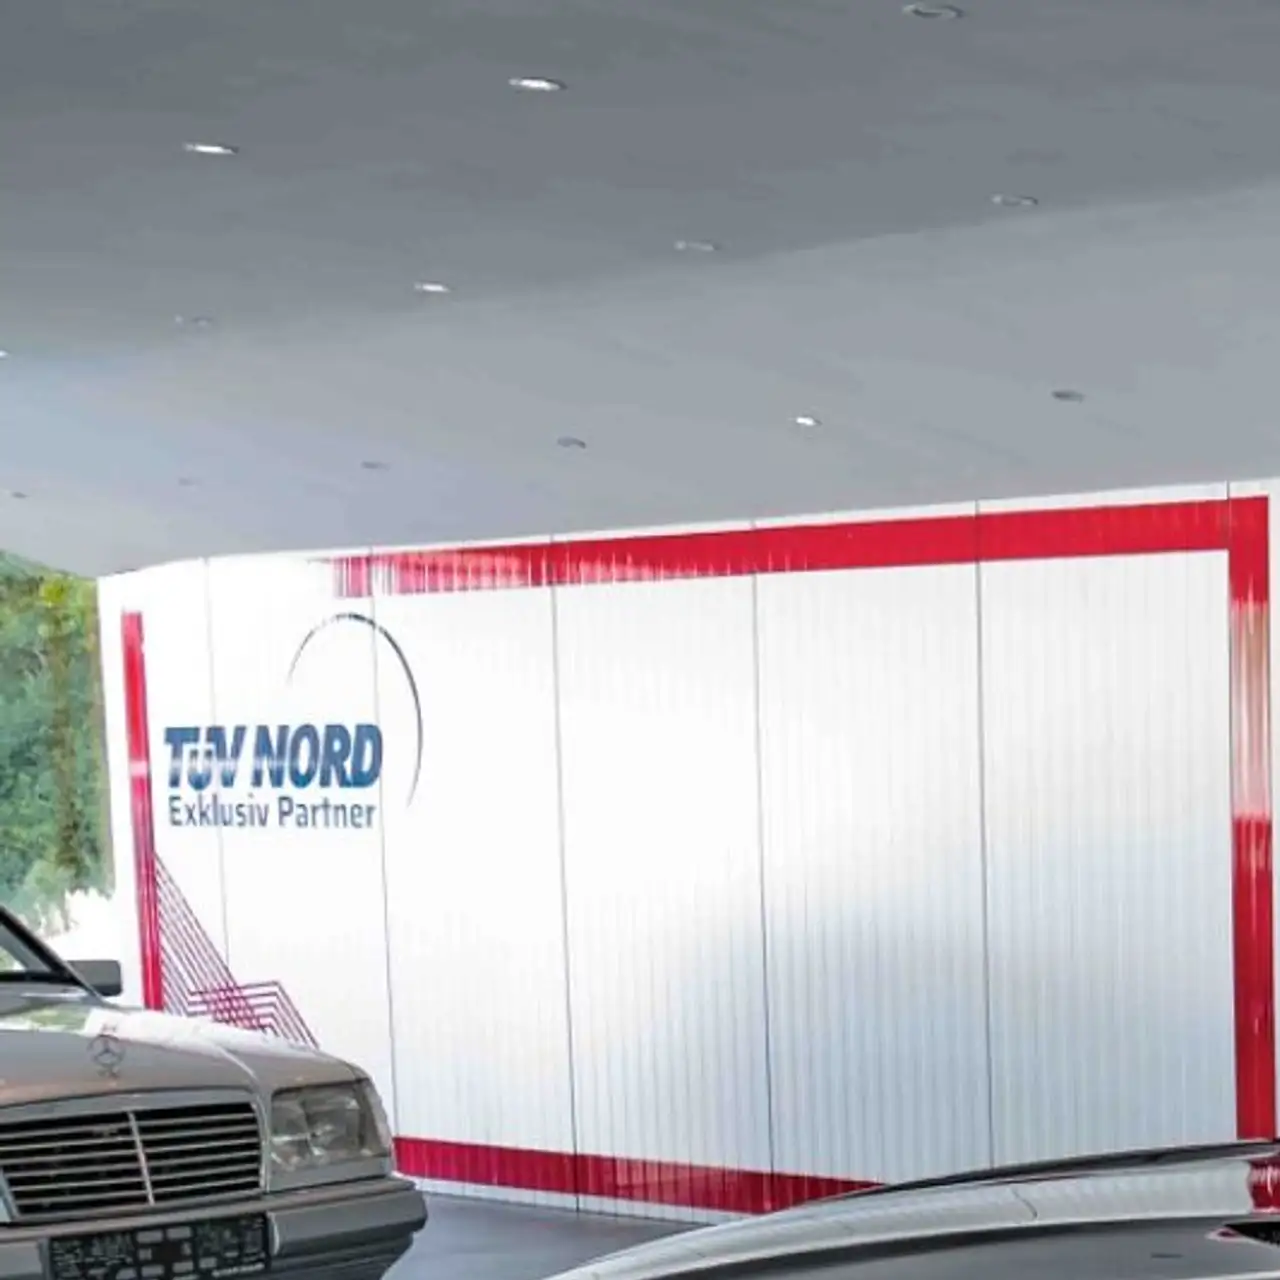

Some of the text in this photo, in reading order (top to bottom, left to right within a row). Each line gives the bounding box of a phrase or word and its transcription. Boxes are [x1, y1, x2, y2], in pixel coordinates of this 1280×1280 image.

[250, 723, 383, 788] NORD
[167, 793, 377, 829] Exklusiv Partner
